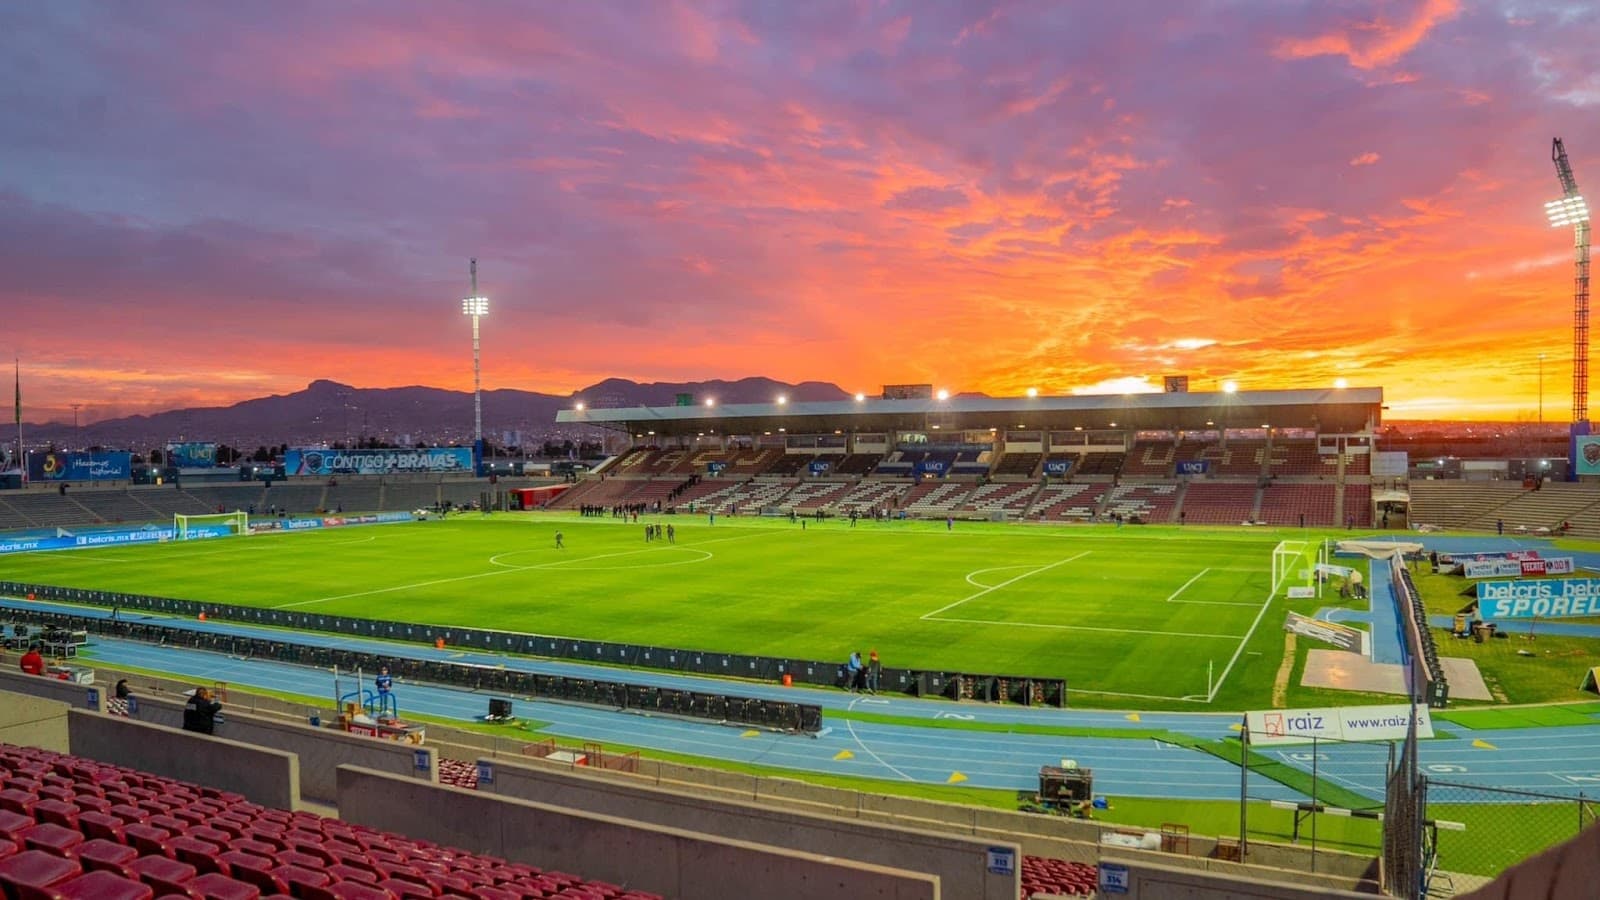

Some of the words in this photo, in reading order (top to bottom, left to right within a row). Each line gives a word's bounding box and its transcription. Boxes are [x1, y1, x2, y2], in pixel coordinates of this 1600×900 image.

[1183, 462, 1204, 472] UACJ
[1484, 582, 1552, 599] betcris
[1287, 712, 1325, 731] raiz
